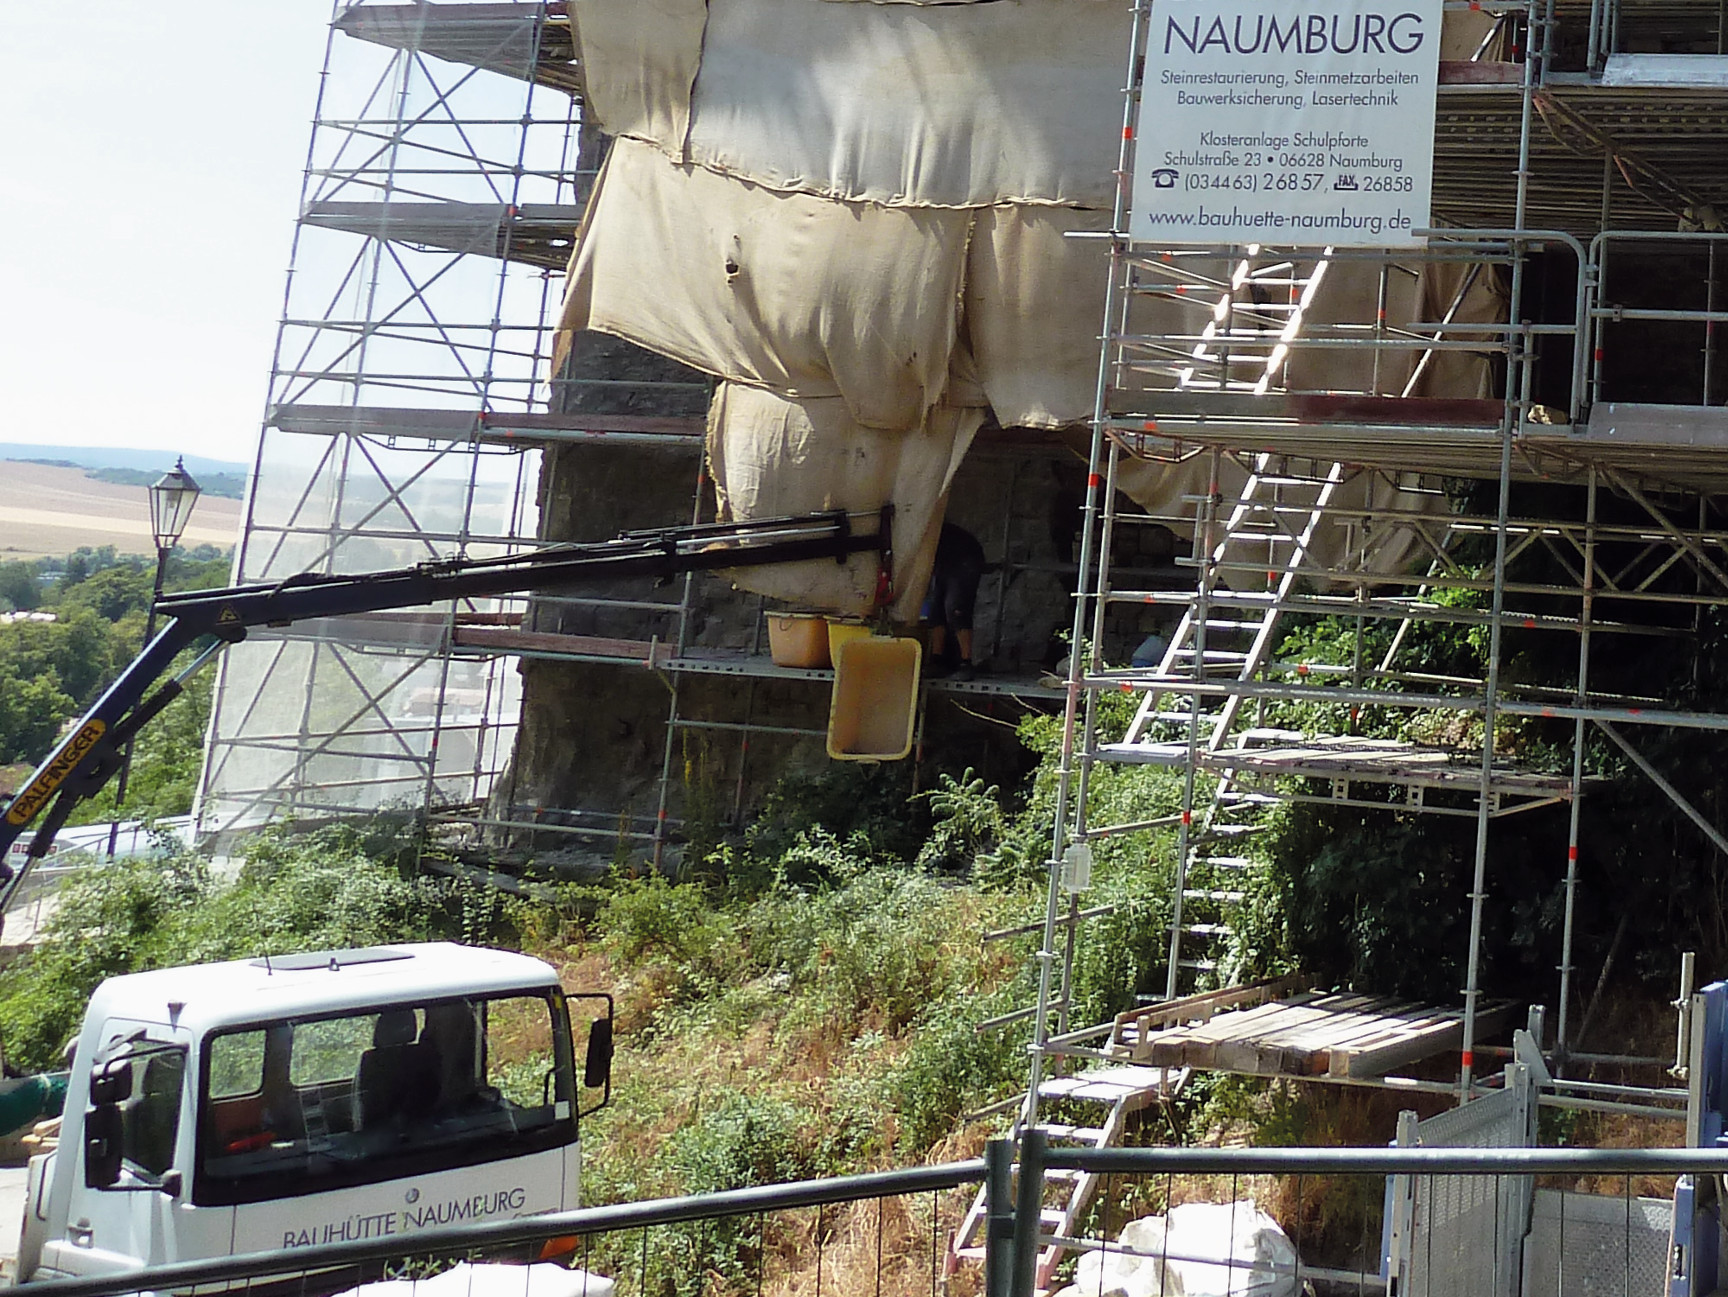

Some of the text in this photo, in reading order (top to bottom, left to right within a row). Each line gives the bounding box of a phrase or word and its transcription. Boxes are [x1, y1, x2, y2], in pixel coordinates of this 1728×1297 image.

[1163, 12, 1424, 55] NAUMBURG
[1160, 68, 1419, 88] Steinrestaurierung, Steinmetzarbeiten
[1177, 90, 1399, 110] Bauwerksicherung, Lasertechnik
[1200, 131, 1369, 153] Klosteranlage Schulpforte
[1164, 151, 1403, 171] Schulstraße 23 06628 Naumburg
[1363, 175, 1414, 192] 26858
[1148, 205, 1412, 235] www.bauhuette-naumburg.de
[13, 725, 100, 818] PALFINGER
[403, 1187, 526, 1229] NAUMBURG
